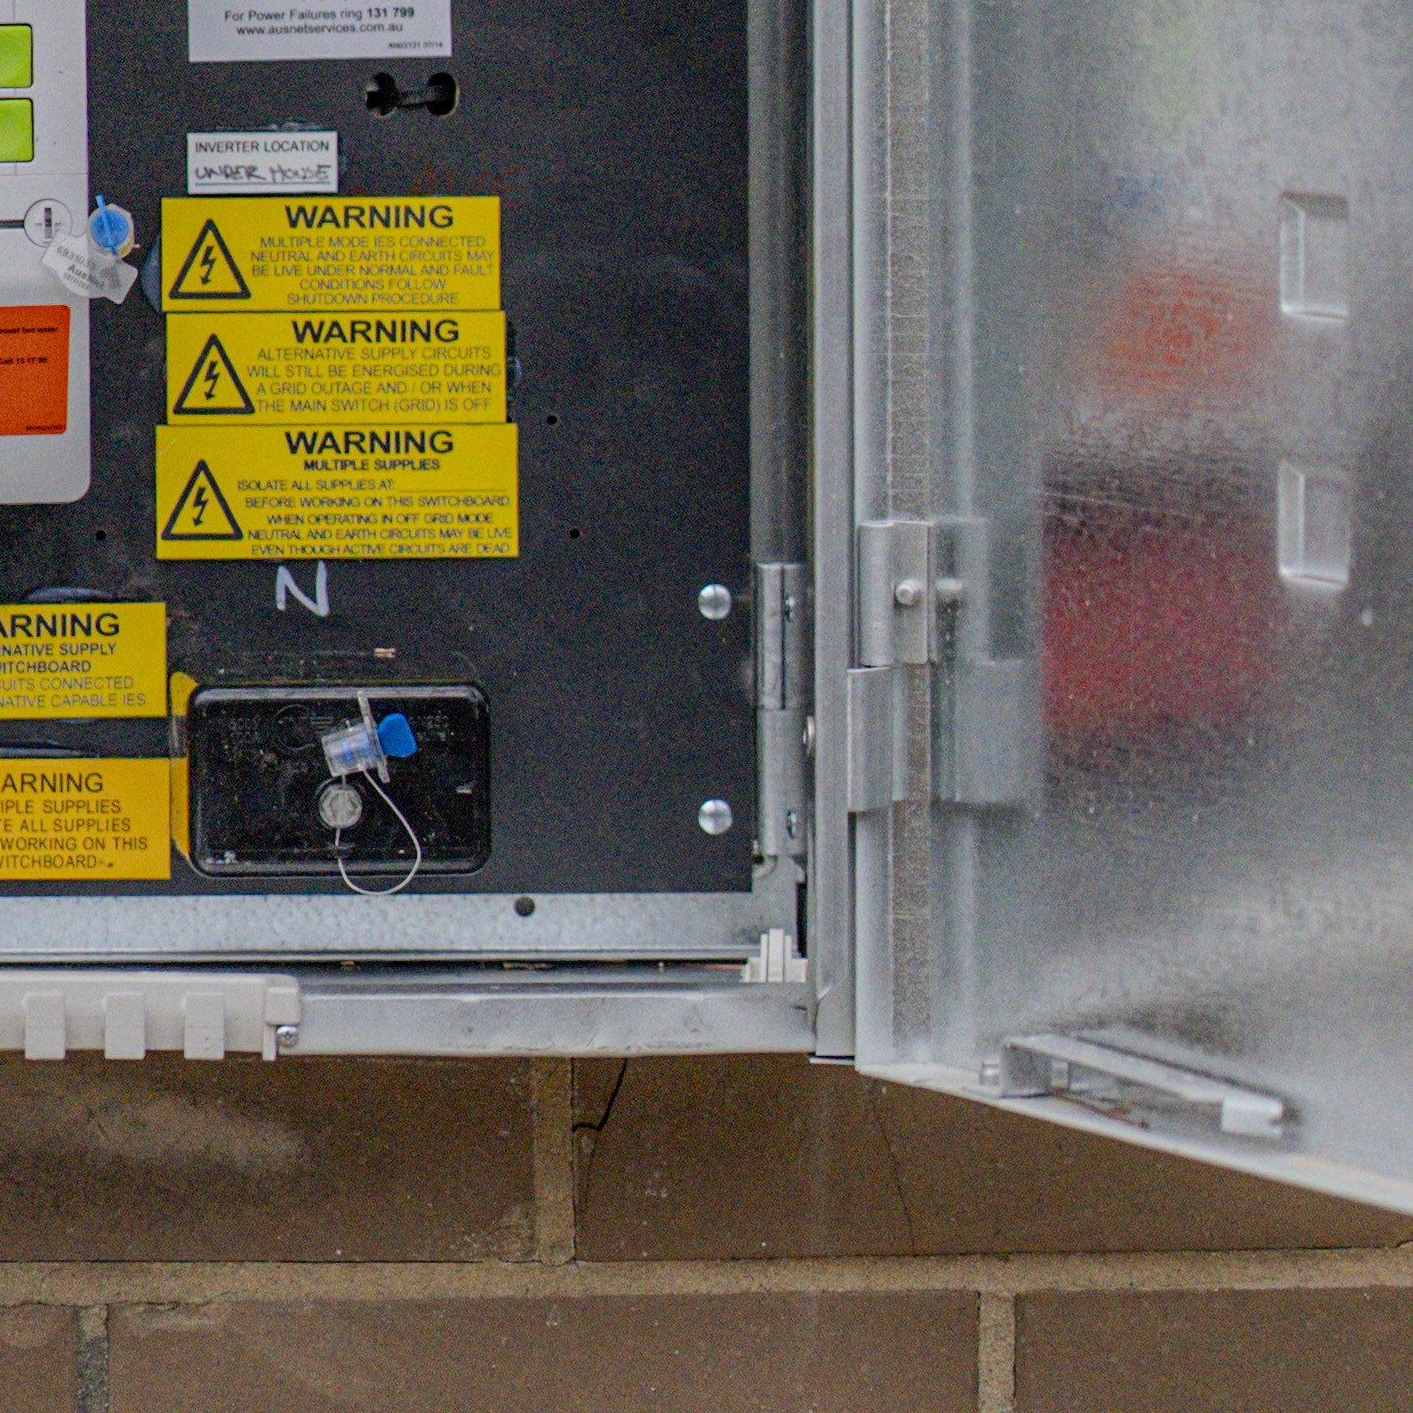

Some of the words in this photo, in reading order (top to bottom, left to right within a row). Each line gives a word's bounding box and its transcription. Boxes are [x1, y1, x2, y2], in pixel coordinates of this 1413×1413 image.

[224, 10, 245, 21] For
[248, 9, 286, 21] Power
[290, 8, 337, 20] Failures
[340, 7, 363, 22] ring
[367, 7, 388, 18] 131
[392, 6, 415, 18] 799
[195, 141, 259, 152] INVERTER
[264, 141, 329, 152] LOCATION
[285, 205, 454, 228] WARNING
[292, 320, 459, 344] WARNING
[258, 347, 354, 361] ALTERNATIVE
[362, 347, 417, 360] SUPPLY
[422, 346, 491, 359] CIRCUITS
[285, 431, 454, 454] WARNING
[304, 460, 369, 471] MULTIPLE
[375, 459, 440, 471] SUPPLIES
[275, 561, 329, 617] N
[60, 643, 116, 656] SUPPLY
[43, 800, 121, 813] SUPPLIES
[20, 819, 46, 832] ALL
[53, 819, 131, 832] SUPPLIES
[0, 837, 77, 851] WORKING
[83, 837, 105, 850] ON
[114, 837, 148, 850] THIS
